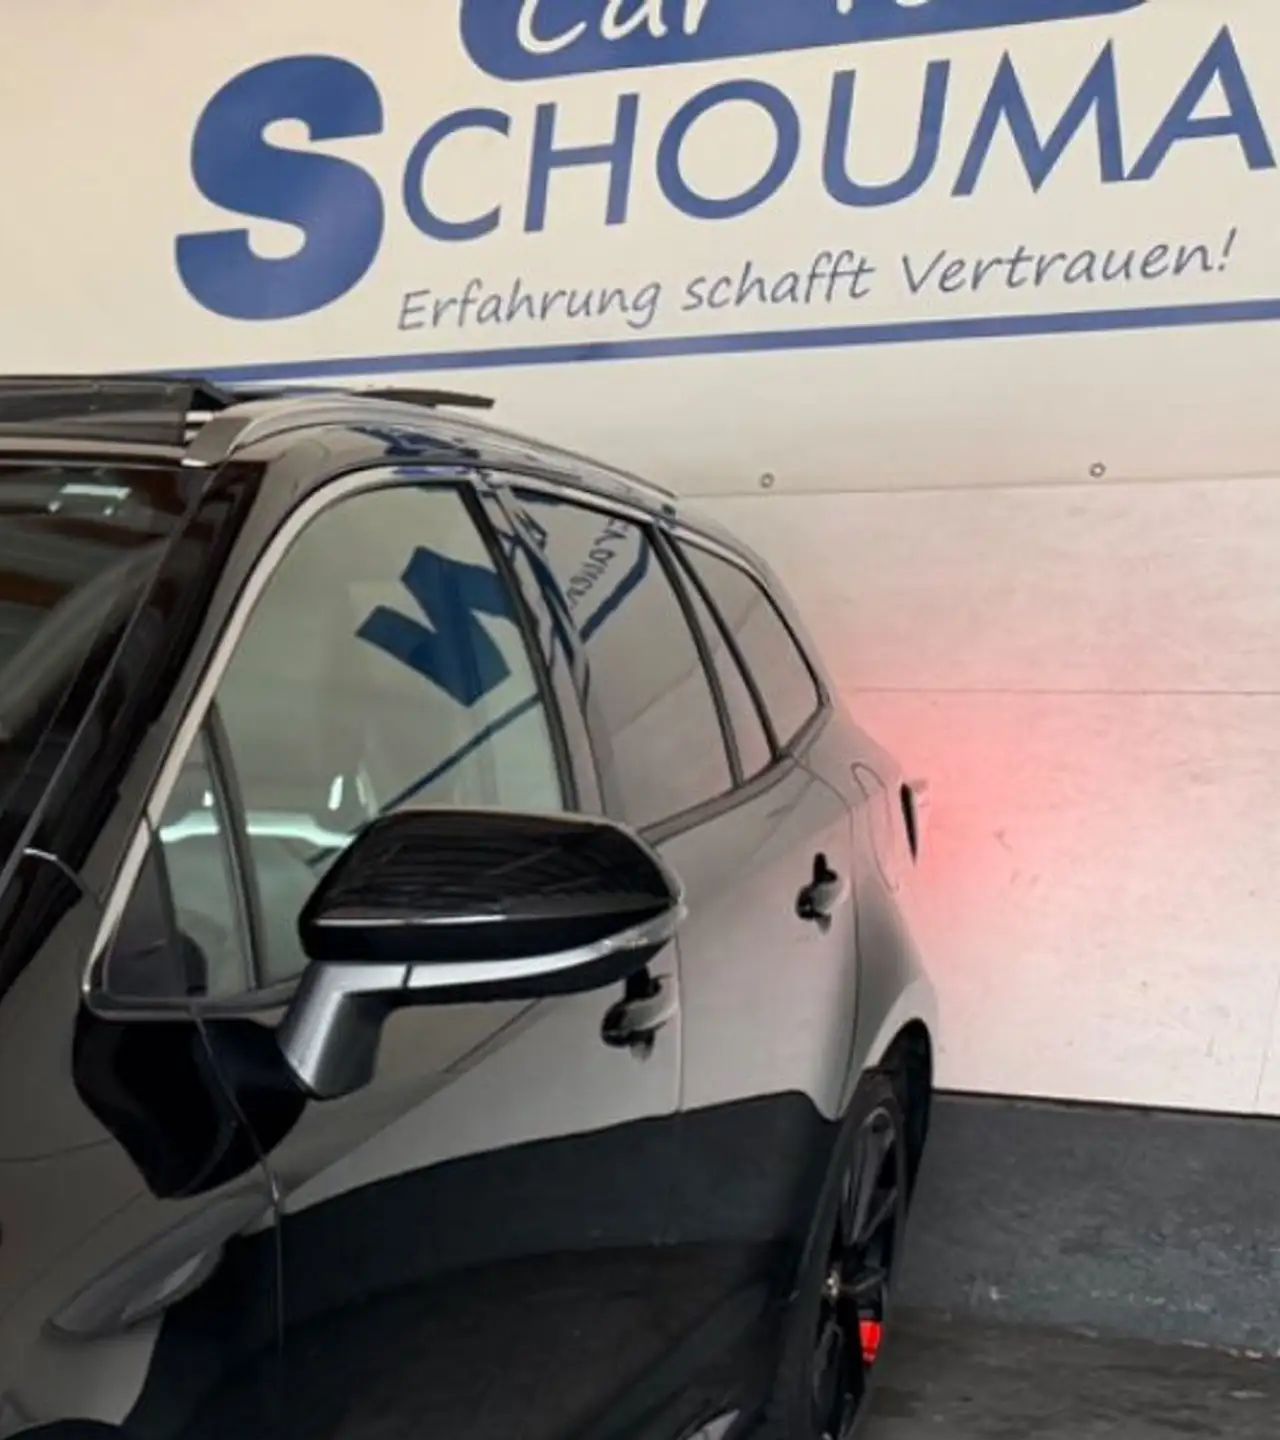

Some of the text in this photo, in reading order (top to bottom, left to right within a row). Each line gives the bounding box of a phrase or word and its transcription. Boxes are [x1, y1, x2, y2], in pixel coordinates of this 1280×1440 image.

[175, 24, 1278, 321] SCHOUMA
[397, 227, 1238, 331] Erfahrung schafft Vertrauen!
